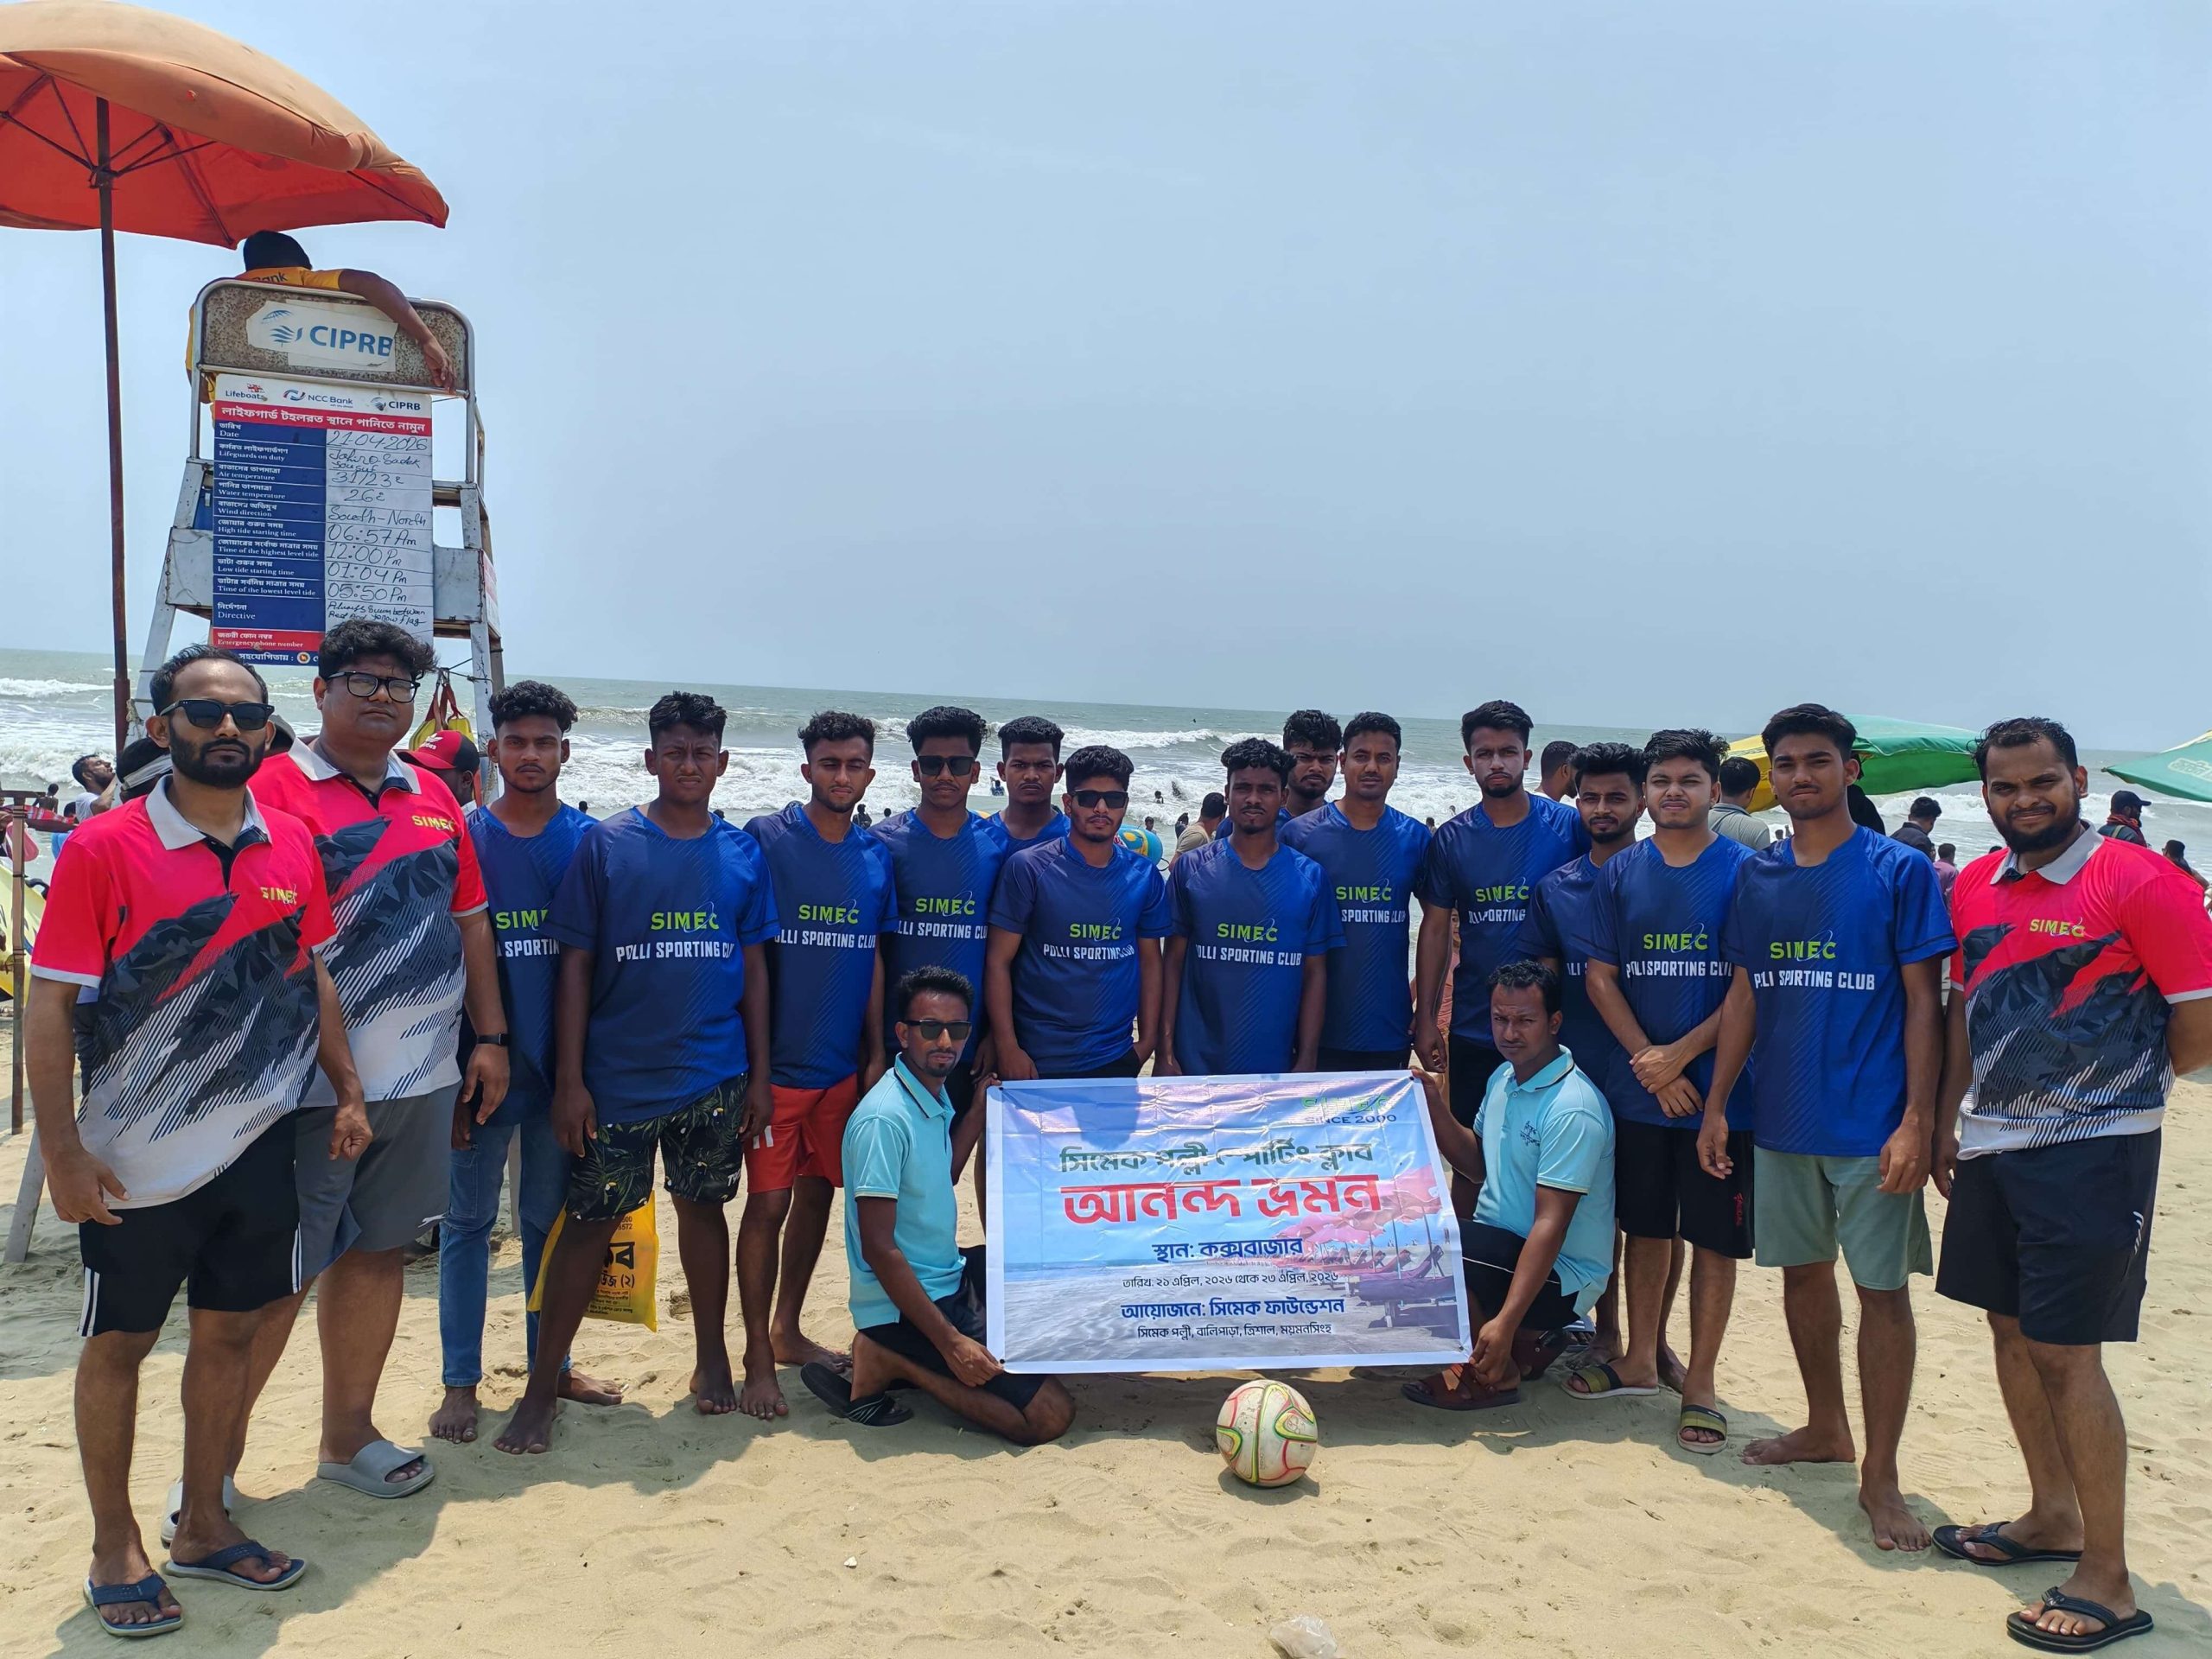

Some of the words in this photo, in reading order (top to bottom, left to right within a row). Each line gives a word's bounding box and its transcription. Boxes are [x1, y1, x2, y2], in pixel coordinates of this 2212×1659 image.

[309, 325, 393, 357] CIPRB
[330, 396, 353, 405] Bank
[389, 401, 421, 410] CIPRB
[219, 422, 241, 430] তারিখ
[221, 405, 278, 420] লাইফগার্ড
[281, 410, 323, 423] টহলরত
[327, 416, 353, 426] স্থানে
[356, 417, 395, 429] পানিতে
[398, 422, 425, 433] নামুন
[219, 450, 257, 459] Lifeguards
[269, 453, 285, 461] duty
[232, 473, 275, 481] temperature
[261, 548, 286, 556] highest
[251, 567, 276, 575] starting
[218, 611, 256, 620] Directive
[218, 639, 254, 647] Emergency
[238, 652, 289, 662] সহযোগিতায়
[412, 816, 456, 832] SIMEC
[260, 886, 297, 906] SIMEC
[1335, 886, 1392, 900] SIMEC
[1475, 885, 1529, 902] SIMEC
[798, 904, 860, 925] SIMEC
[915, 898, 976, 915] SIMEC
[495, 909, 549, 930] SIM
[651, 912, 719, 930] SIMEC
[1341, 909, 1389, 923] SPORTING
[896, 920, 913, 935] LLI
[918, 922, 971, 938] SPORTING
[975, 925, 988, 939] CLU
[1070, 923, 1122, 940] SIMEC
[1217, 923, 1278, 942] SIMEC
[2030, 918, 2086, 938] SIMEC
[774, 929, 798, 944] LLI
[802, 931, 855, 948] SPORTING
[1643, 933, 1708, 950] SIMEC
[505, 938, 560, 957] SPORTIN
[616, 943, 651, 962] POLLI
[656, 941, 721, 958] SPORTING
[1043, 944, 1070, 958] POLLI
[1196, 944, 1217, 960] OLLI
[1220, 947, 1274, 964] SPORTING
[1278, 952, 1302, 966] CLUB
[1770, 941, 1837, 959] SIMEC
[1647, 961, 1706, 976] SPORTING
[1838, 972, 1875, 990] CLUB
[1306, 1116, 1351, 1124] SINCE
[1355, 1114, 1397, 1123] 2000
[1059, 1146, 1147, 1172] সিমেক
[1316, 1142, 1374, 1171] ক্লাব
[1060, 1178, 1242, 1224] আনন্দ
[1251, 1174, 1382, 1217] ভ্রমন
[1152, 1243, 1194, 1262] স্থান:
[1198, 1238, 1302, 1258] কক্সবাজার
[601, 1269, 618, 1288] উজ
[620, 1274, 635, 1288] (২)
[1122, 1275, 1154, 1287] তারিখ:
[1156, 1278, 1170, 1287] ২১
[1172, 1274, 1202, 1287] এপ্রিল,
[1205, 1275, 1232, 1285] ২০২৬
[1236, 1274, 1259, 1283] থেকে
[1262, 1274, 1275, 1283] ২৩
[1279, 1270, 1308, 1284] এপ্রিল,
[1311, 1272, 1338, 1282] ২০২৬
[1121, 1303, 1206, 1320] আয়োজনে:
[1209, 1297, 1261, 1316] সিমেক
[1264, 1296, 1344, 1314] ফাউন্ডেশন
[1138, 1325, 1169, 1338] সিমেক
[1172, 1324, 1194, 1341] পল্লী,
[1196, 1324, 1242, 1338] বালিপাড়া,
[1244, 1323, 1278, 1336] ত্রিশাল,
[1280, 1322, 1332, 1336] ময়মনসিংহ
